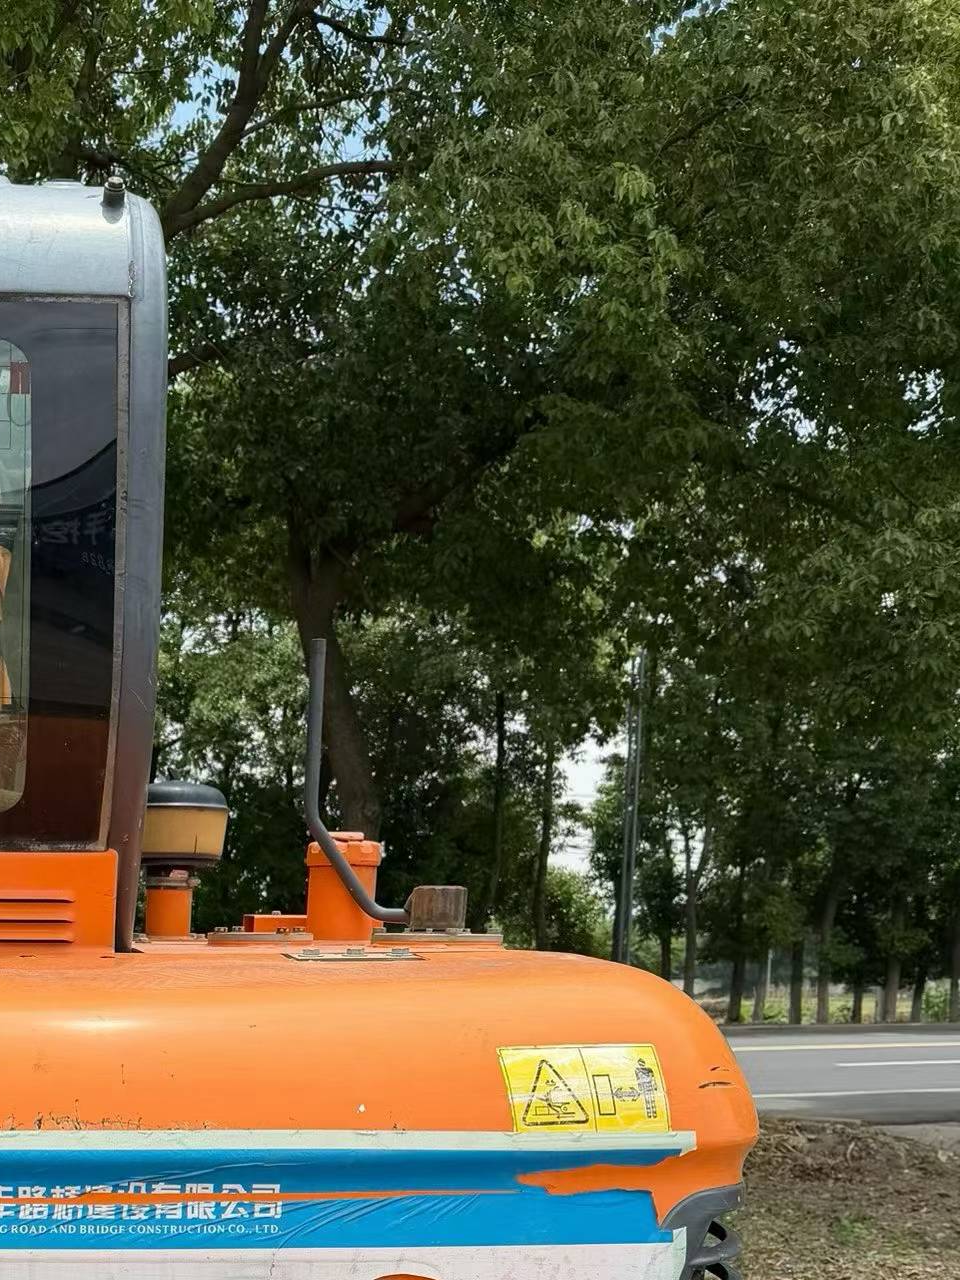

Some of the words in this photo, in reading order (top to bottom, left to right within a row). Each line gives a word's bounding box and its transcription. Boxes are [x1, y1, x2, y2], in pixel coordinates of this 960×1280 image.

[11, 1224, 47, 1234] ROAD
[49, 1224, 76, 1234] AND
[79, 1224, 125, 1234] BRIDGE
[128, 1224, 225, 1234] CONSTRUCTION
[255, 1224, 282, 1234] LTD.
